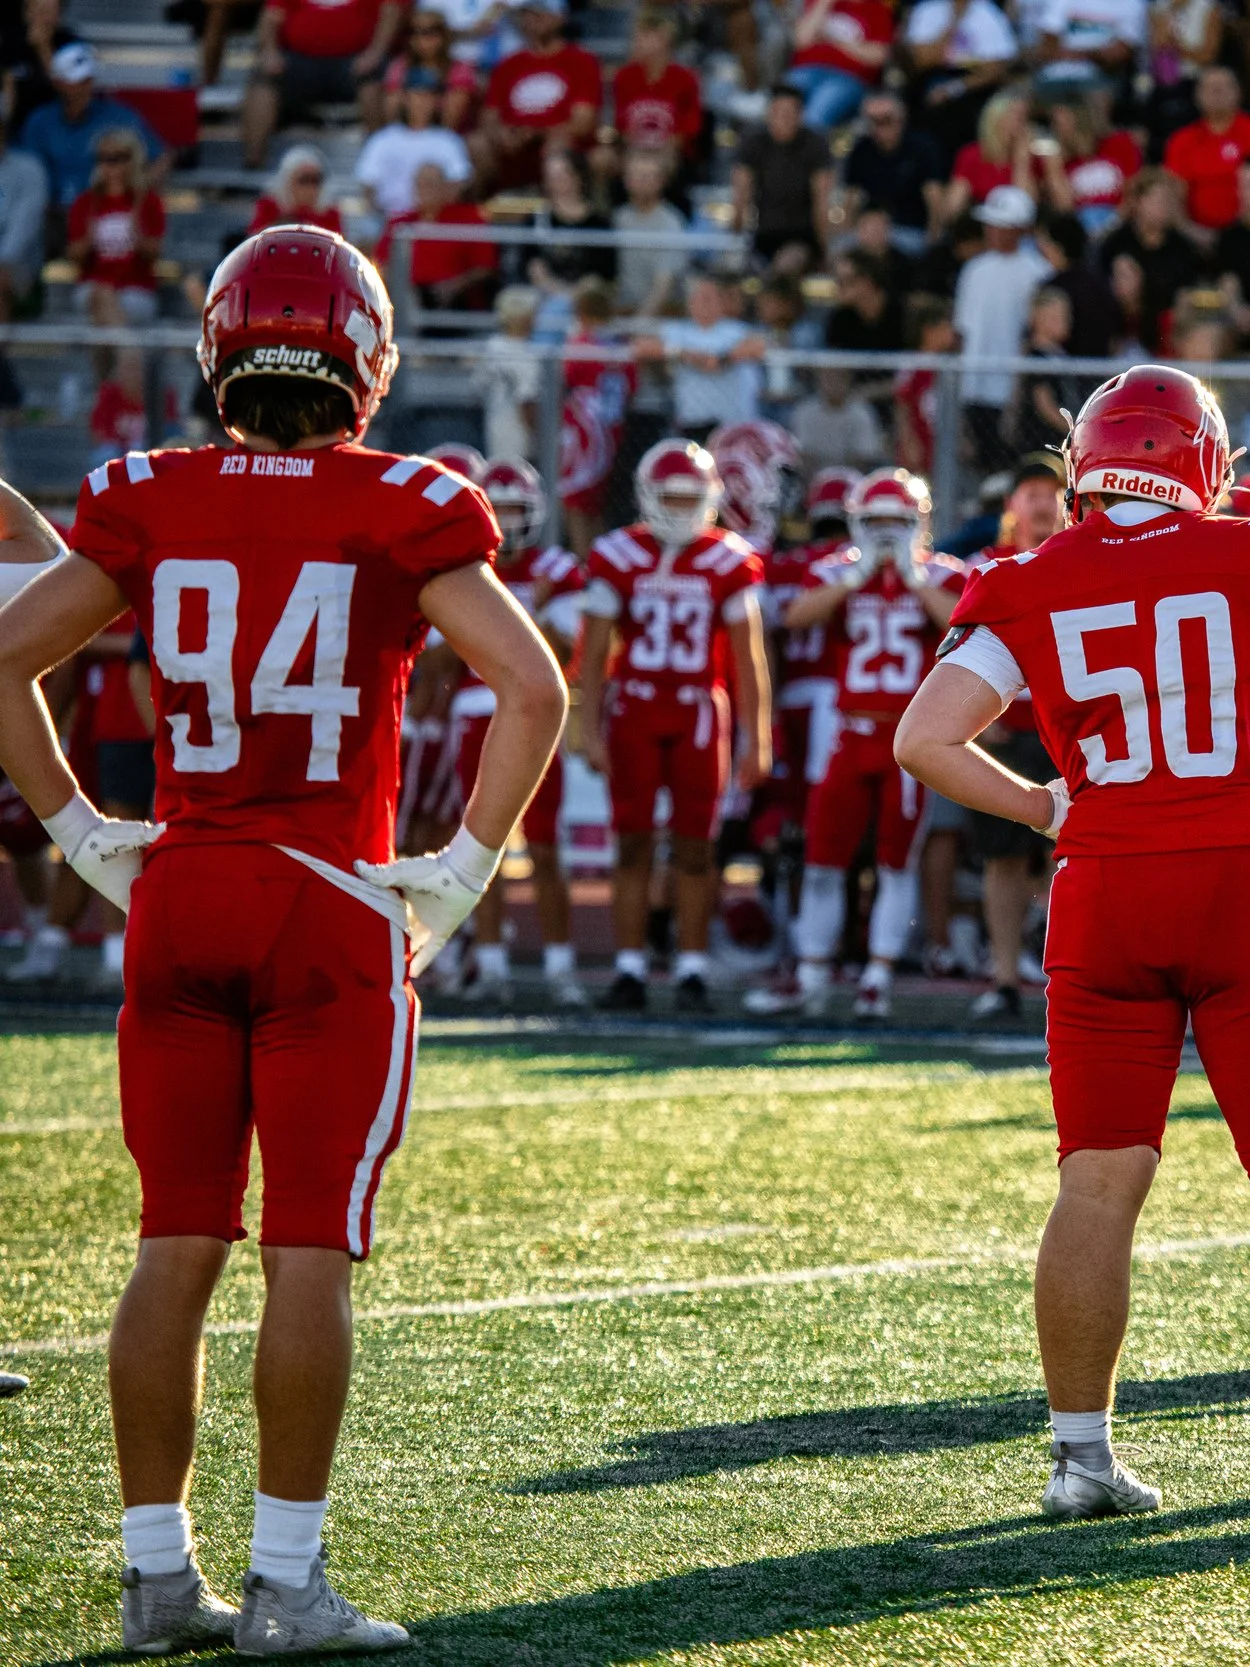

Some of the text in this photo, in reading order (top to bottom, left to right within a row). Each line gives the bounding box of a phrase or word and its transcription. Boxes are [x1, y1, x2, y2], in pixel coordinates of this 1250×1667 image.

[219, 454, 315, 477] RED KINGDOM
[1102, 471, 1182, 503] Riddell
[1101, 536, 1124, 545] RED
[151, 558, 361, 782] 94
[629, 597, 712, 673] 33
[846, 611, 924, 693] 25
[1049, 591, 1238, 786] 50
